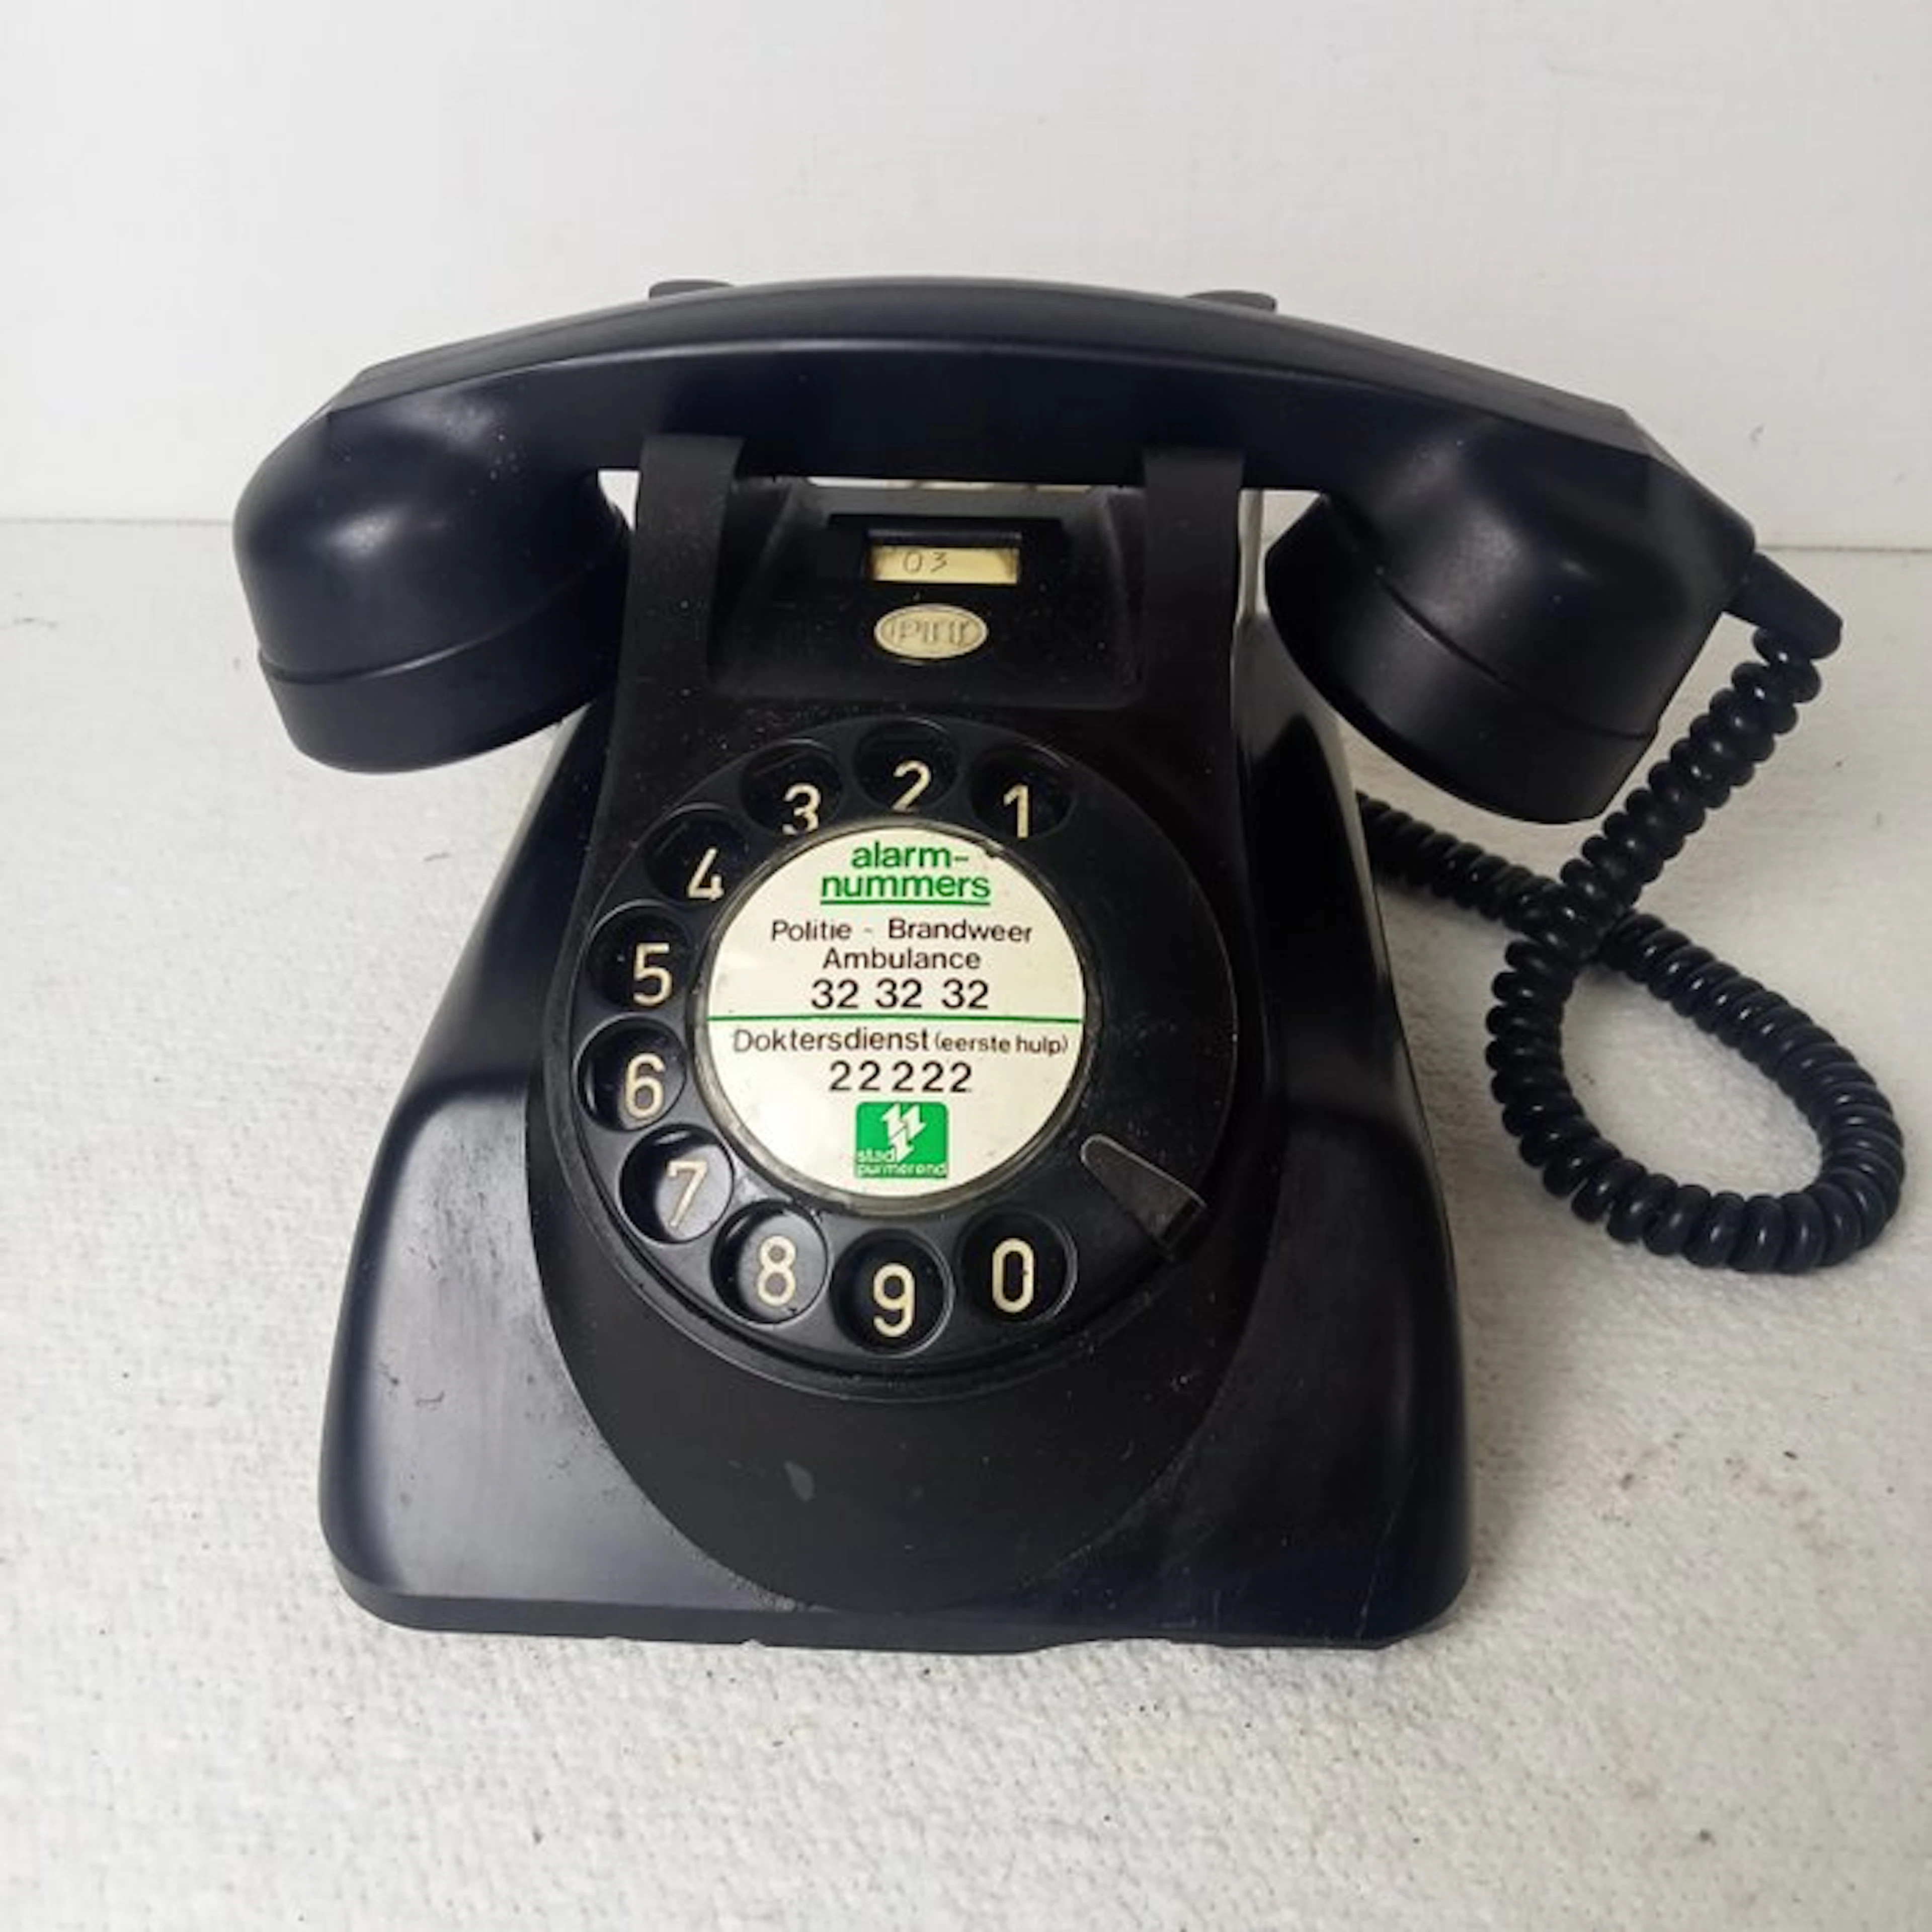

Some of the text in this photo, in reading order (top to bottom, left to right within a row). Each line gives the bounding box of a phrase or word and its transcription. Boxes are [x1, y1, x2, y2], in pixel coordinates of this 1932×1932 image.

[784, 785, 822, 835] 3
[894, 761, 930, 811] 2
[1004, 786, 1028, 838] 1
[688, 848, 724, 901] 4
[851, 841, 969, 869] alarm-
[821, 874, 991, 899] nummers
[772, 920, 851, 941] Politie
[889, 918, 1032, 942] Brandweer
[634, 943, 672, 1005] 5
[823, 947, 981, 970] Ambulance
[811, 978, 988, 1010] 32 32 32
[734, 1027, 1069, 1057] Doktersdienst (eerste hulp)
[624, 1054, 665, 1119] 6
[668, 1161, 707, 1229] 7
[756, 1236, 796, 1307] 8
[993, 1239, 1034, 1312] 0
[873, 1263, 915, 1337] 9
